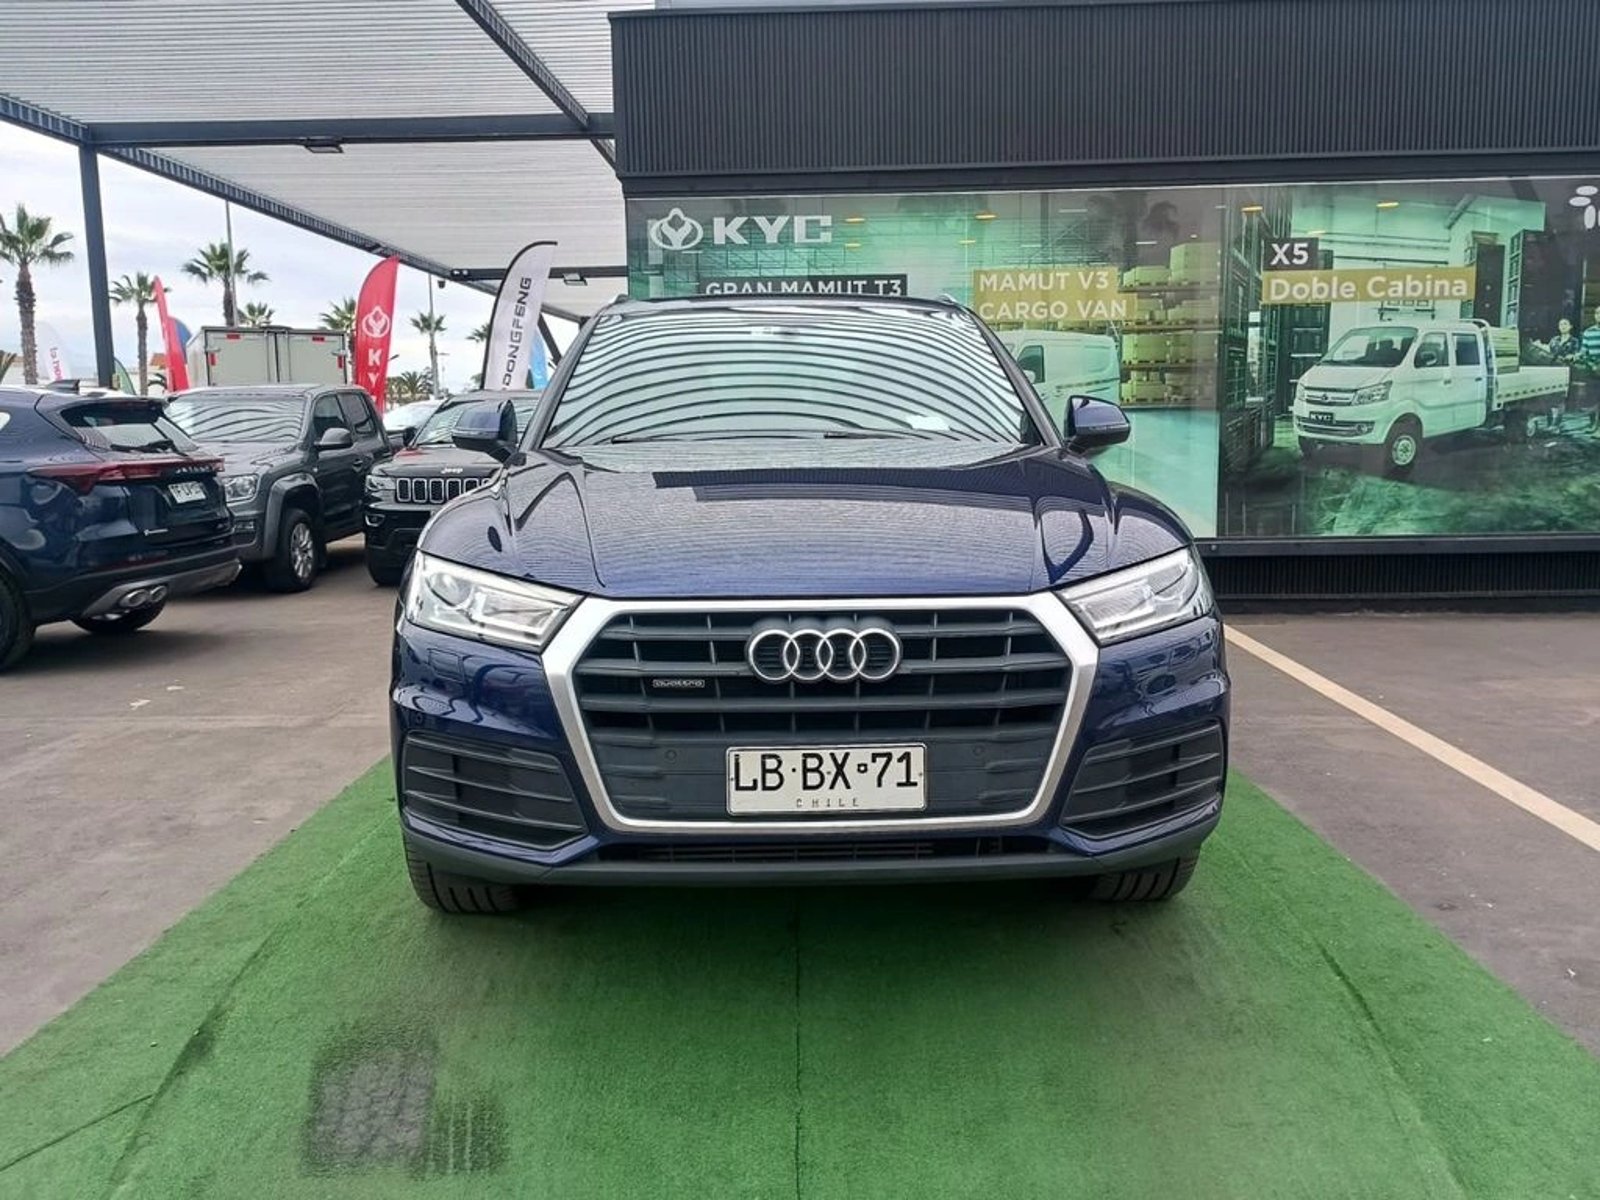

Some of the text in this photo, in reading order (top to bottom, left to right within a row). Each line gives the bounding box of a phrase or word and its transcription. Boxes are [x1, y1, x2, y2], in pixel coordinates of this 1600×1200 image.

[713, 215, 832, 245] KYC
[1270, 243, 1309, 265] X5
[705, 279, 901, 296] GRAN MAMUT T3
[979, 271, 1109, 292] MAMUT V3
[1269, 274, 1467, 301] Doble Cabina
[979, 299, 1126, 320] CARGO VAN
[502, 277, 532, 387] DONGFENG
[796, 798, 859, 808] CHILE
